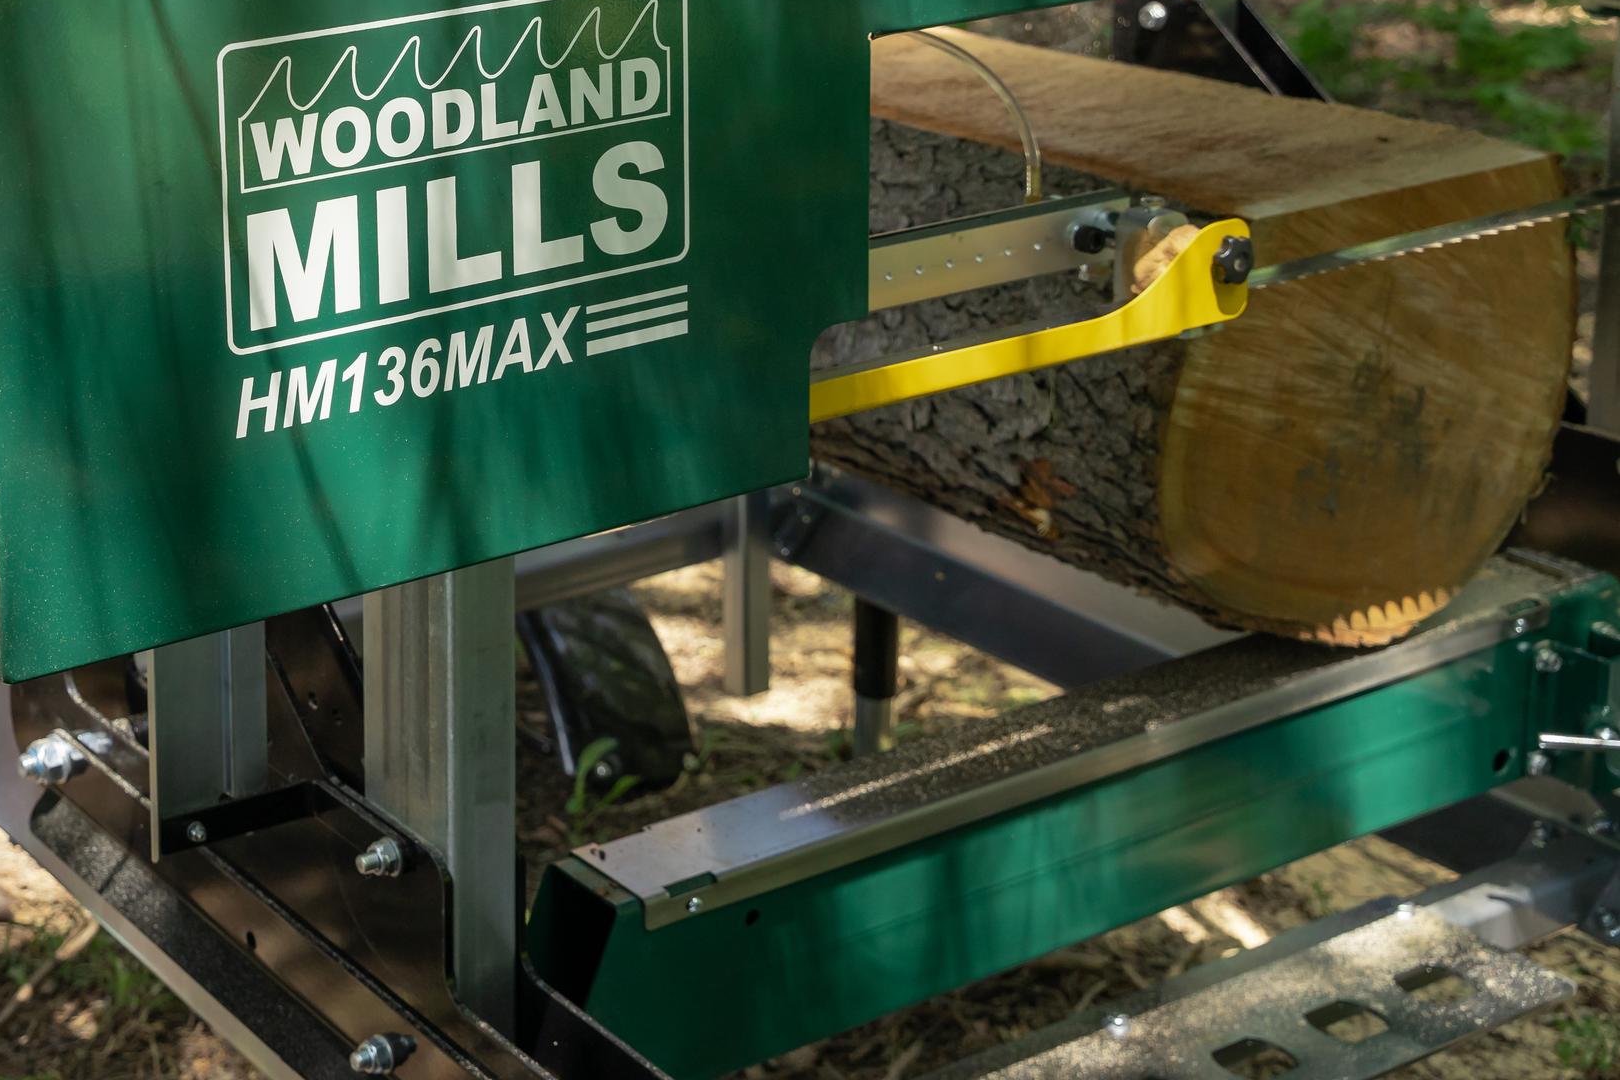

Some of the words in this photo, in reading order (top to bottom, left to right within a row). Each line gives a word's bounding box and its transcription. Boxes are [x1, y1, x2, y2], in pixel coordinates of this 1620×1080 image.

[250, 57, 661, 182] WOODLAND
[246, 140, 668, 332] MILLS
[235, 305, 581, 440] HM136MAX
